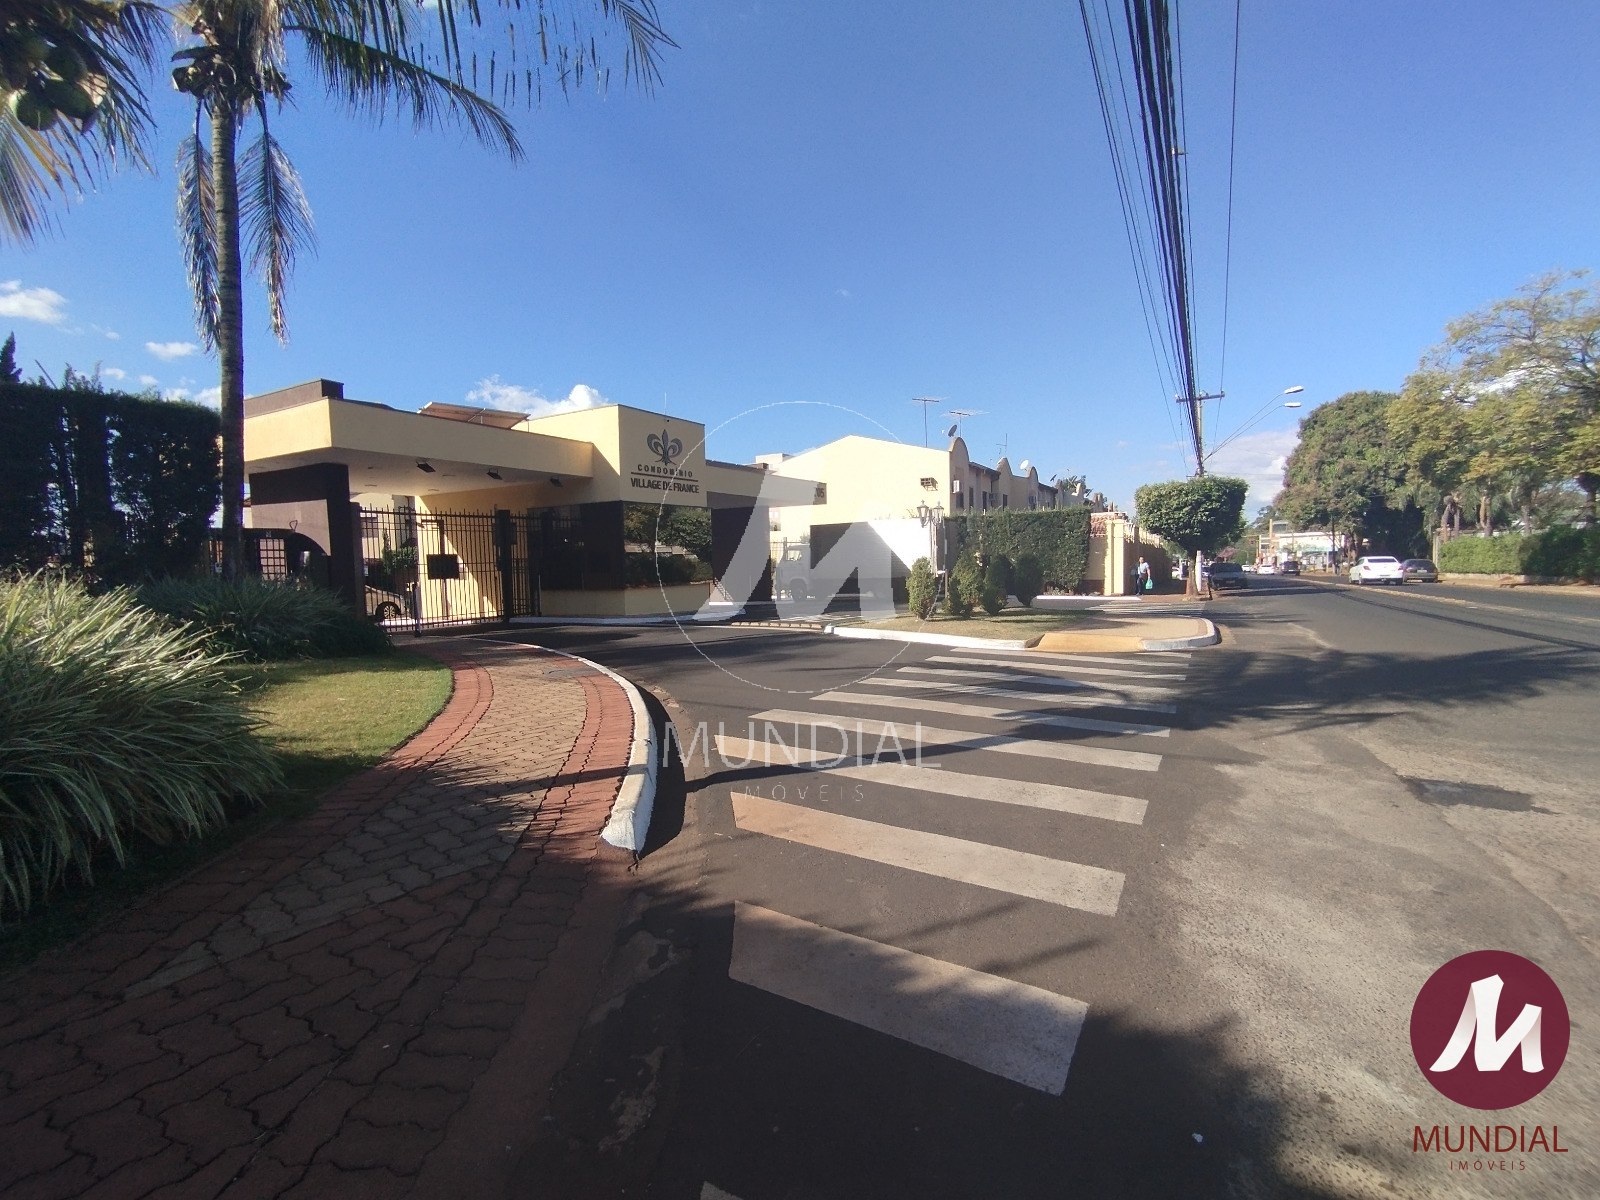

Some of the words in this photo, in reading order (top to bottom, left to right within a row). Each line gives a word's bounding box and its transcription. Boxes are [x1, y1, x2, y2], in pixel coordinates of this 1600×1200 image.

[630, 477, 662, 490] VILLAGE
[662, 481, 673, 491] DE
[673, 482, 700, 493] FRANCE
